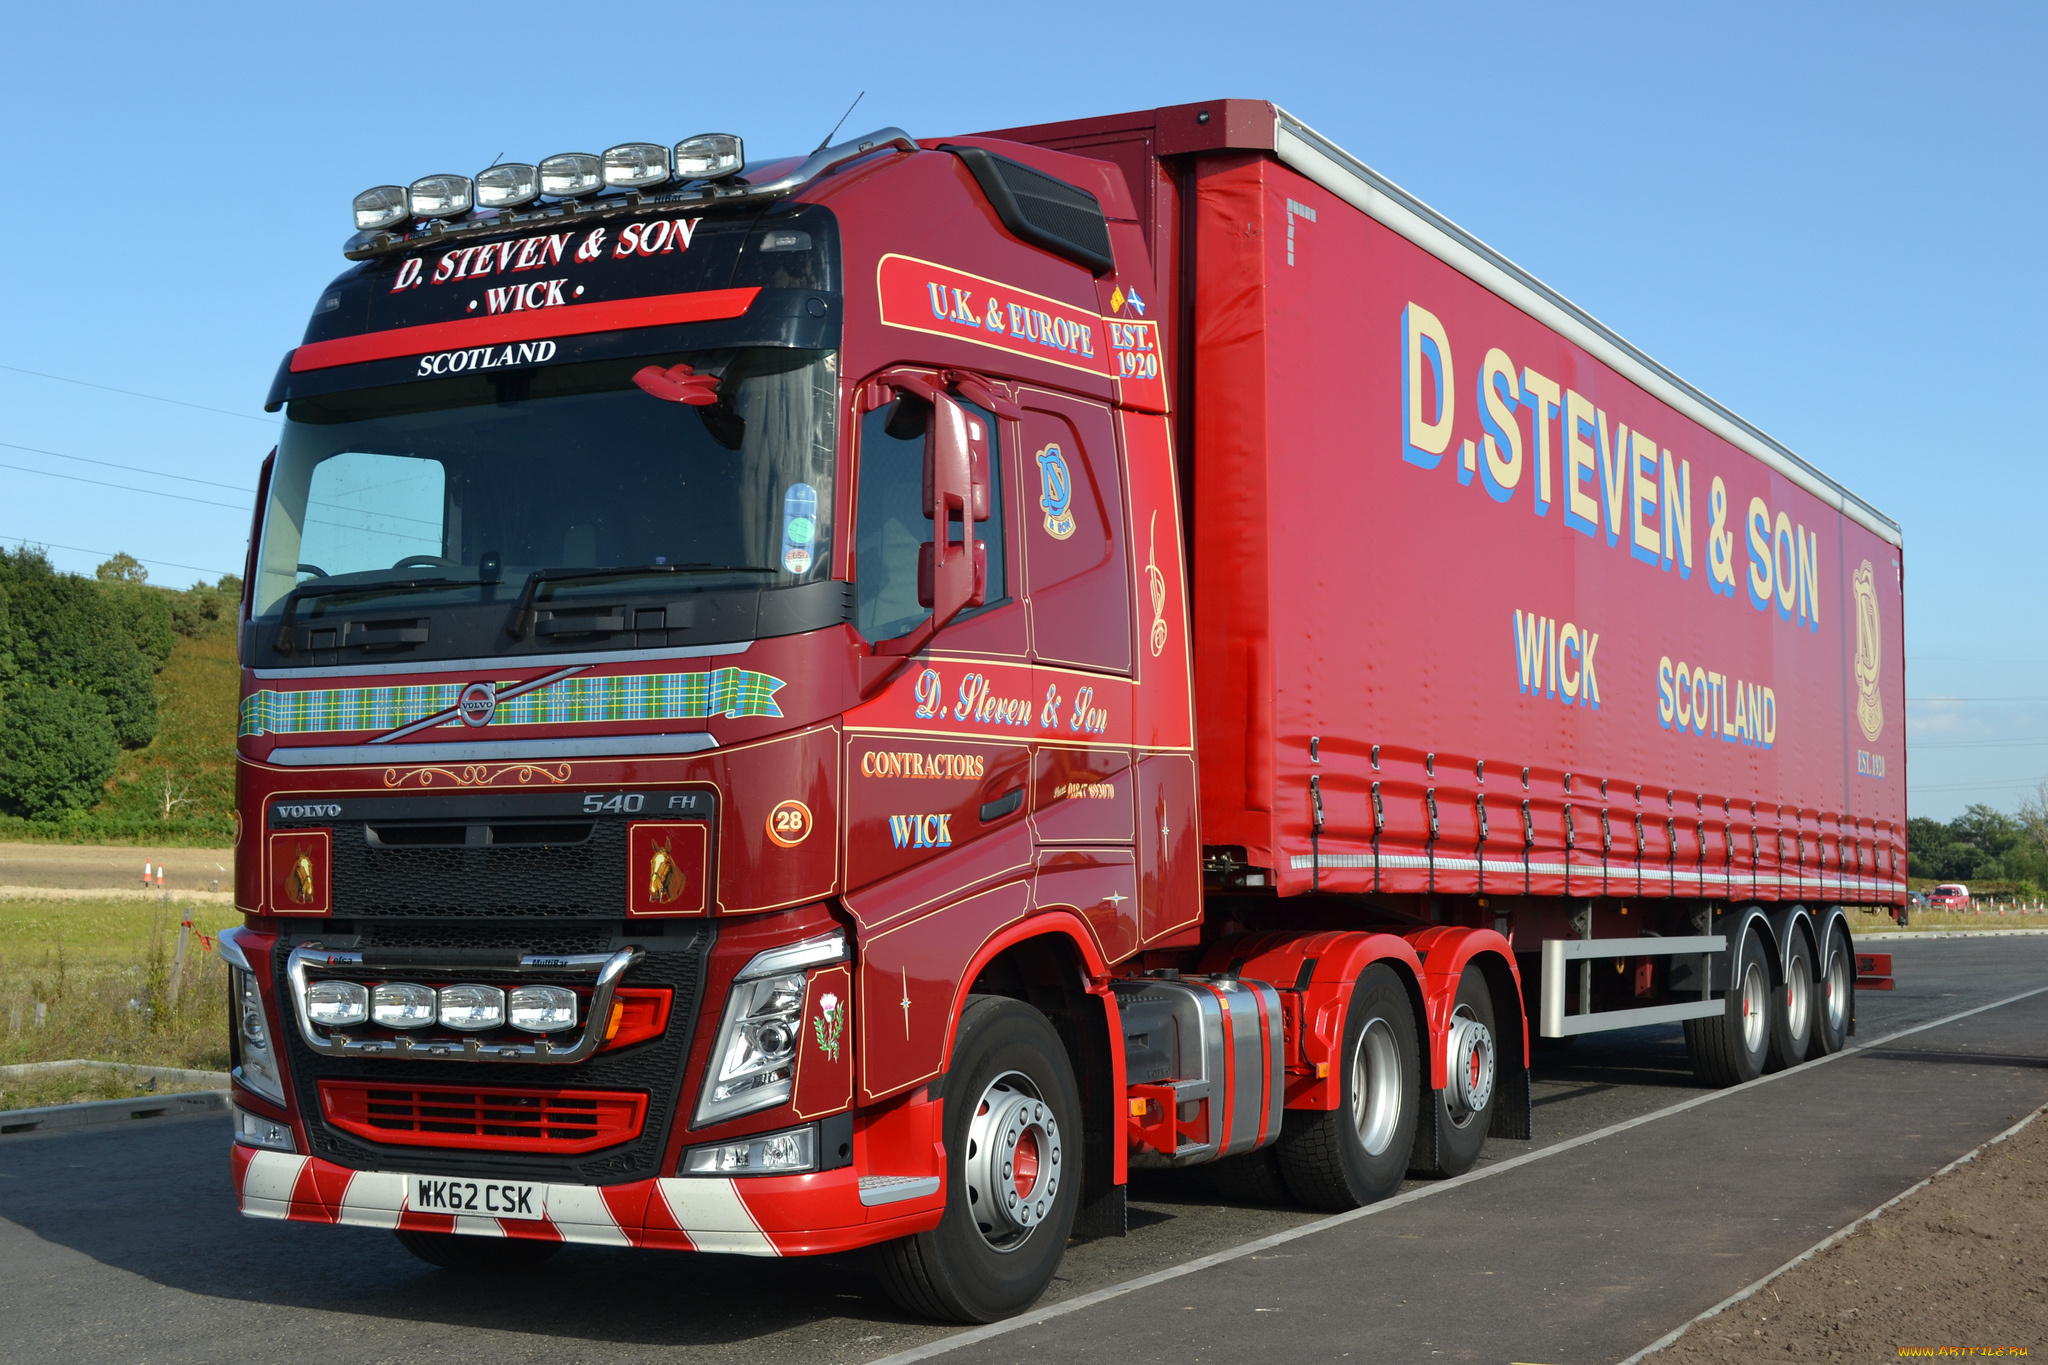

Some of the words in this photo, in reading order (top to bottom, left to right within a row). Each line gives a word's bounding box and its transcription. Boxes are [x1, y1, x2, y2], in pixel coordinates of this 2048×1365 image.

[391, 258, 423, 293] D.
[431, 231, 575, 284] STEVEN
[575, 232, 605, 264] &
[611, 216, 703, 261] SON
[485, 278, 569, 316] WICK
[927, 282, 982, 328] U.K.
[986, 297, 1006, 332] &
[1008, 302, 1095, 359] EUROPE
[1109, 323, 1155, 351] EST.
[417, 340, 557, 378] SCOTLAND
[1117, 352, 1159, 380] 1920
[1706, 475, 1736, 598] &
[1746, 496, 1819, 634] SON
[1513, 608, 1600, 711] WICK
[462, 701, 494, 710] VOLVO
[915, 668, 948, 720] D.
[954, 672, 1033, 727] Steven
[1041, 683, 1062, 729] &
[1070, 685, 1108, 734] Son
[1657, 655, 1776, 750] SCOTLAND
[861, 750, 984, 780] CONTRACTORS
[277, 803, 341, 819] VOLVO
[583, 794, 645, 814] 540
[668, 795, 697, 809] FH
[775, 811, 803, 832] 28
[889, 813, 952, 849] WICK
[327, 955, 353, 966] Kelsa
[531, 959, 569, 968] MultiBar
[418, 1180, 478, 1210] WK62
[485, 1184, 533, 1214] CSK
